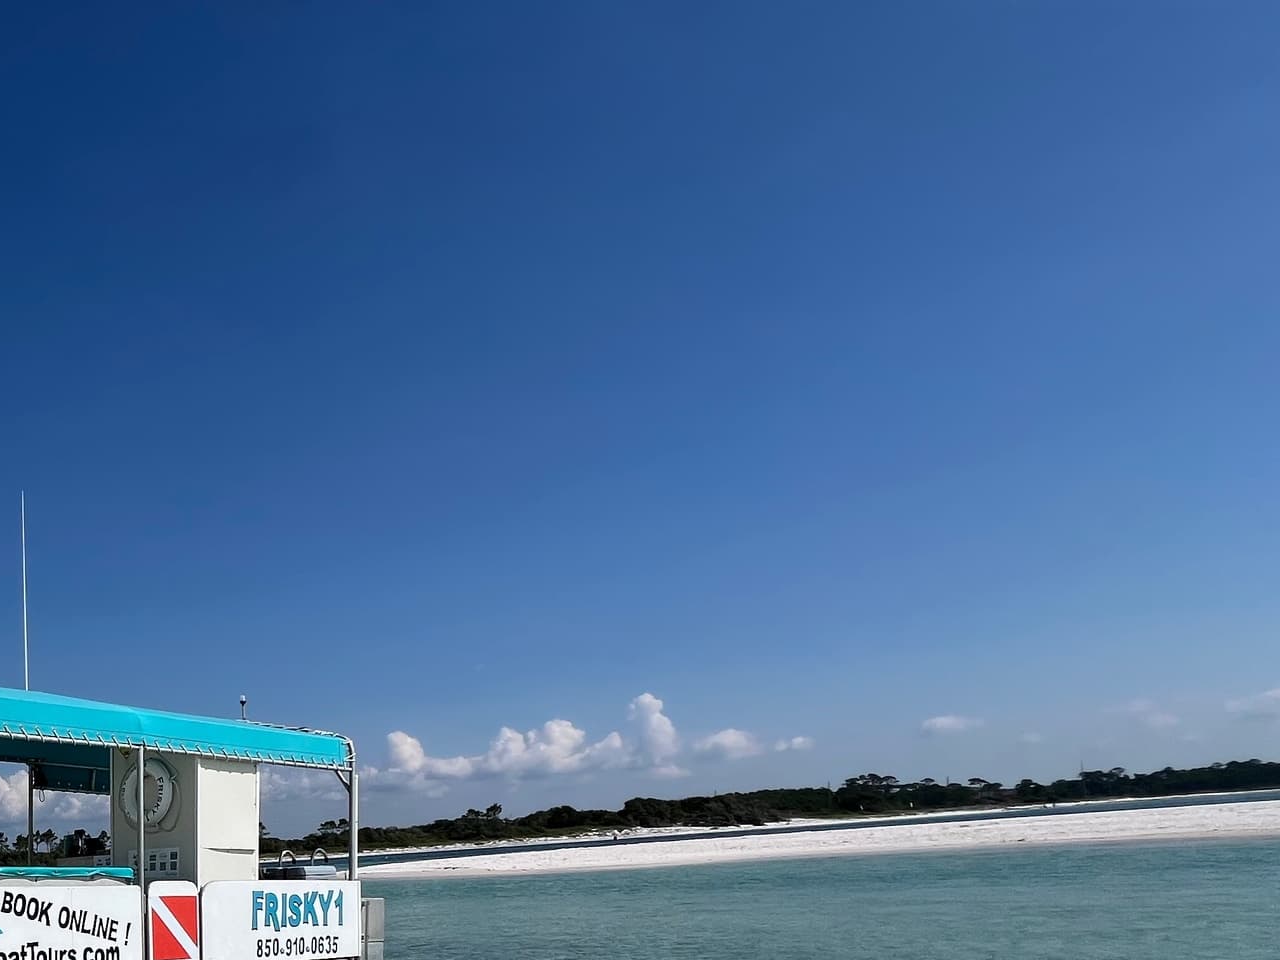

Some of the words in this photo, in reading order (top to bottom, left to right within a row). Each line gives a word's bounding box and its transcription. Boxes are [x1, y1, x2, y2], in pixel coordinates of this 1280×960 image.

[1, 891, 53, 926] BOOK
[58, 906, 119, 942] ONLINE
[251, 889, 344, 932] FRISKY1
